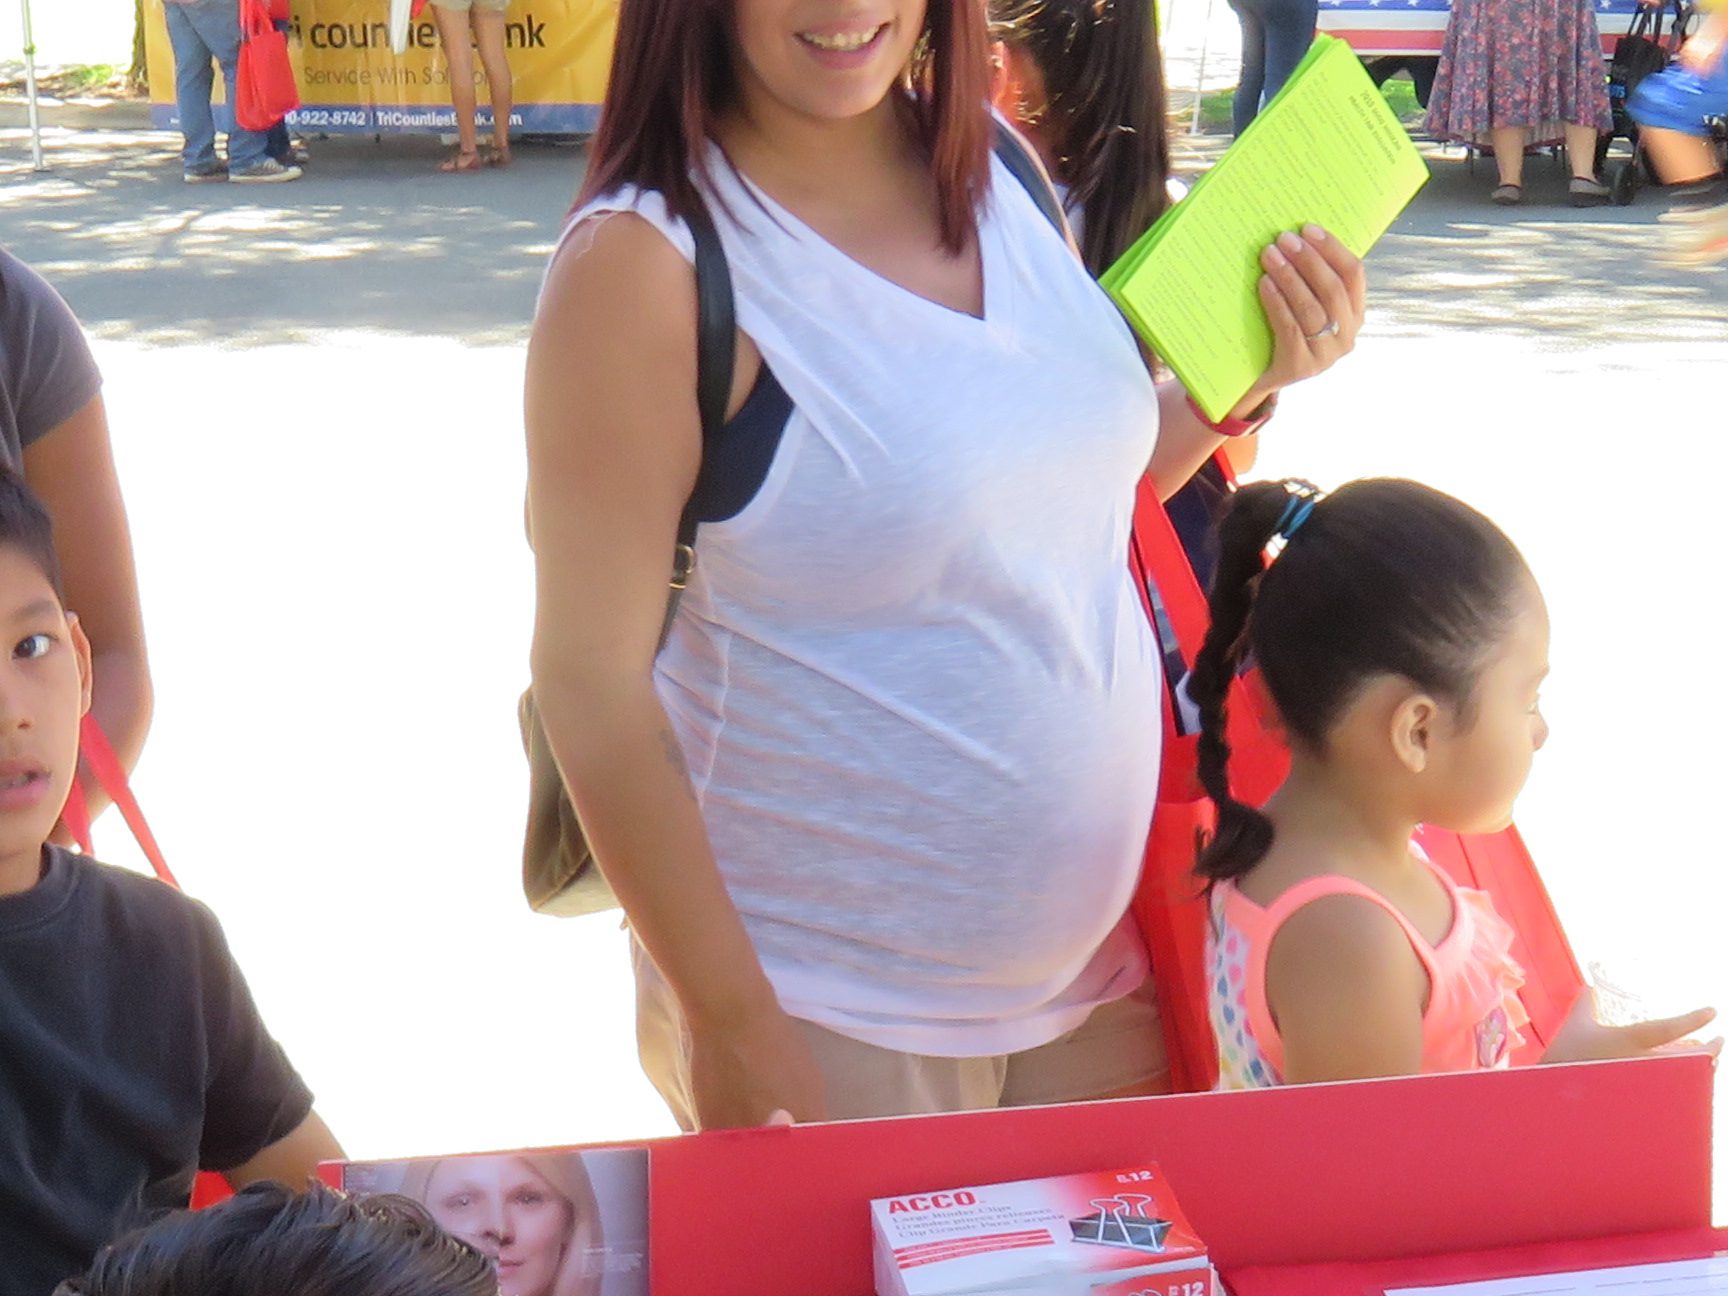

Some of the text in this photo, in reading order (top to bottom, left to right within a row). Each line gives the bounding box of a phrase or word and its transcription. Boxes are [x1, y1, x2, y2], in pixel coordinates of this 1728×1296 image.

[304, 66, 372, 86] Service
[377, 66, 417, 85] With
[888, 1190, 977, 1214] ACCO
